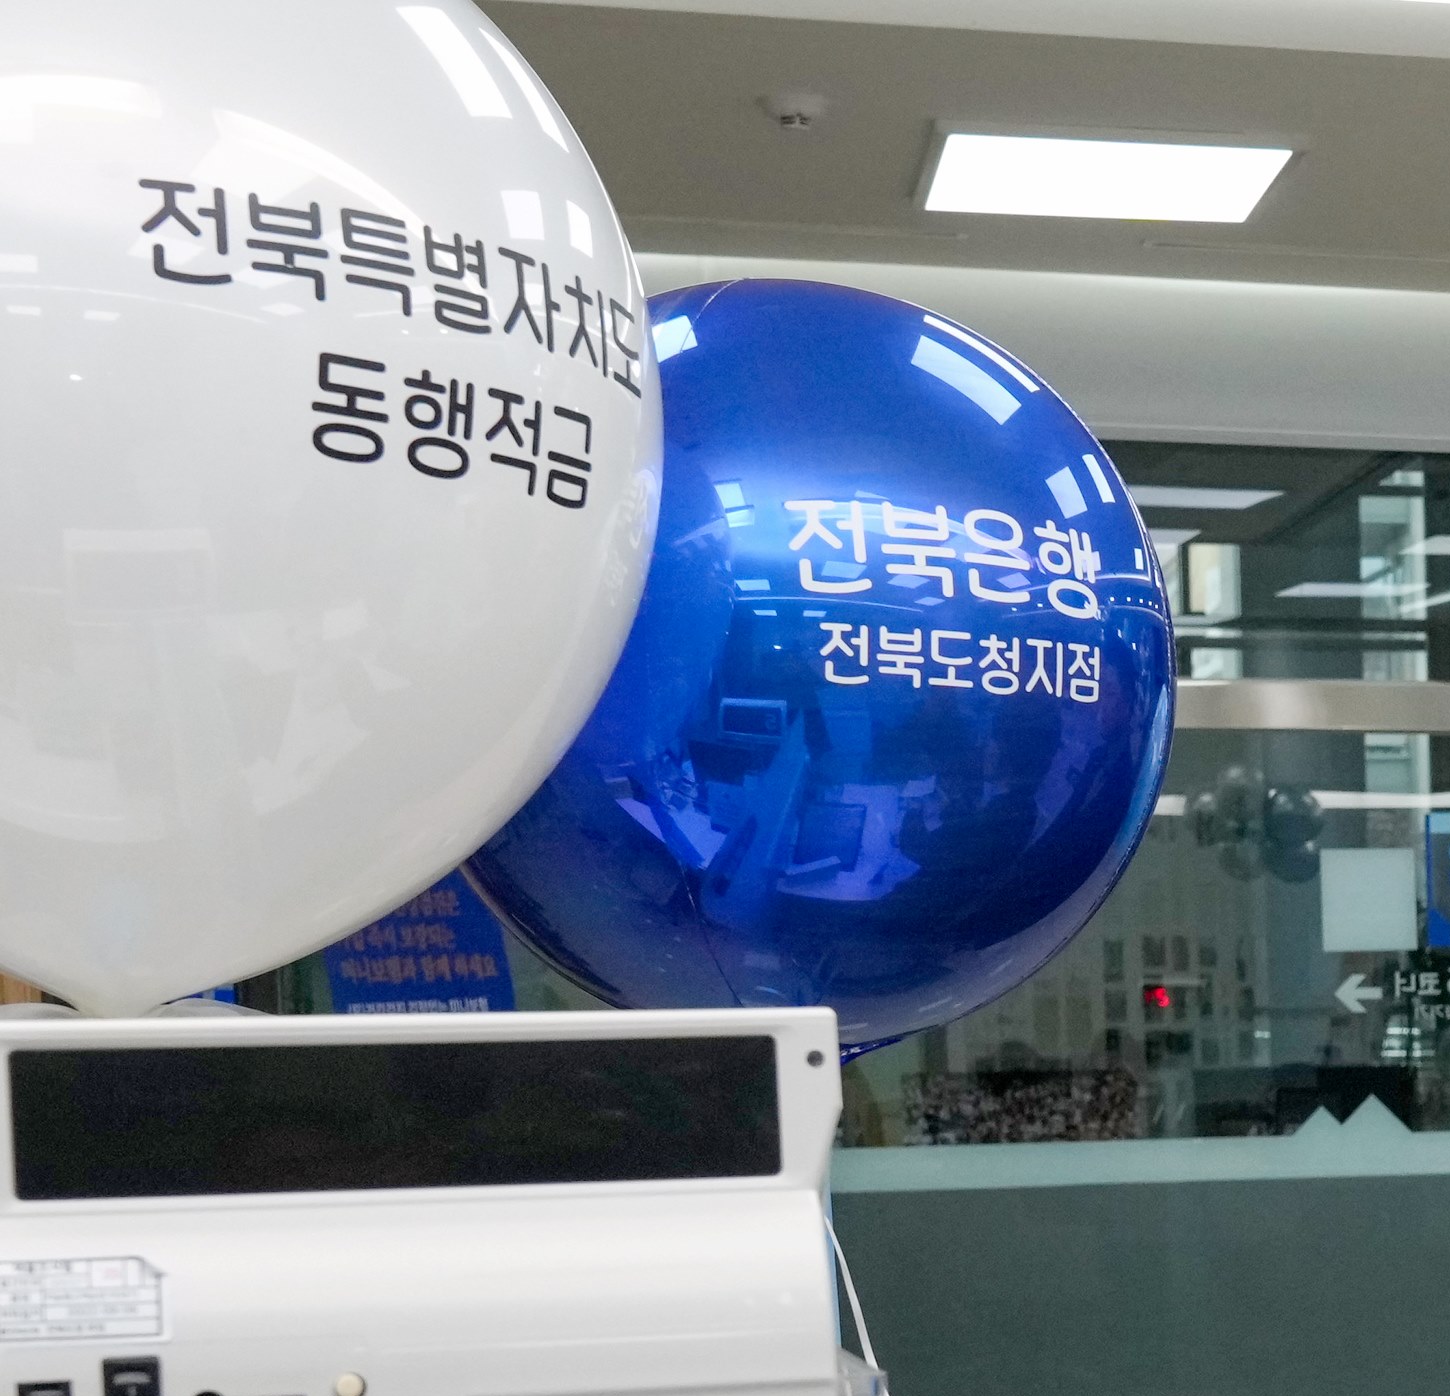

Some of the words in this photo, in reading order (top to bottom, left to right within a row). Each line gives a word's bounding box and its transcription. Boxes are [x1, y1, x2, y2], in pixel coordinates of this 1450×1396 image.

[137, 177, 643, 400] 전북특별자치도
[309, 350, 595, 510] 동행적금
[783, 499, 1101, 620] 전북은행
[818, 621, 1103, 704] 전북도청지점
